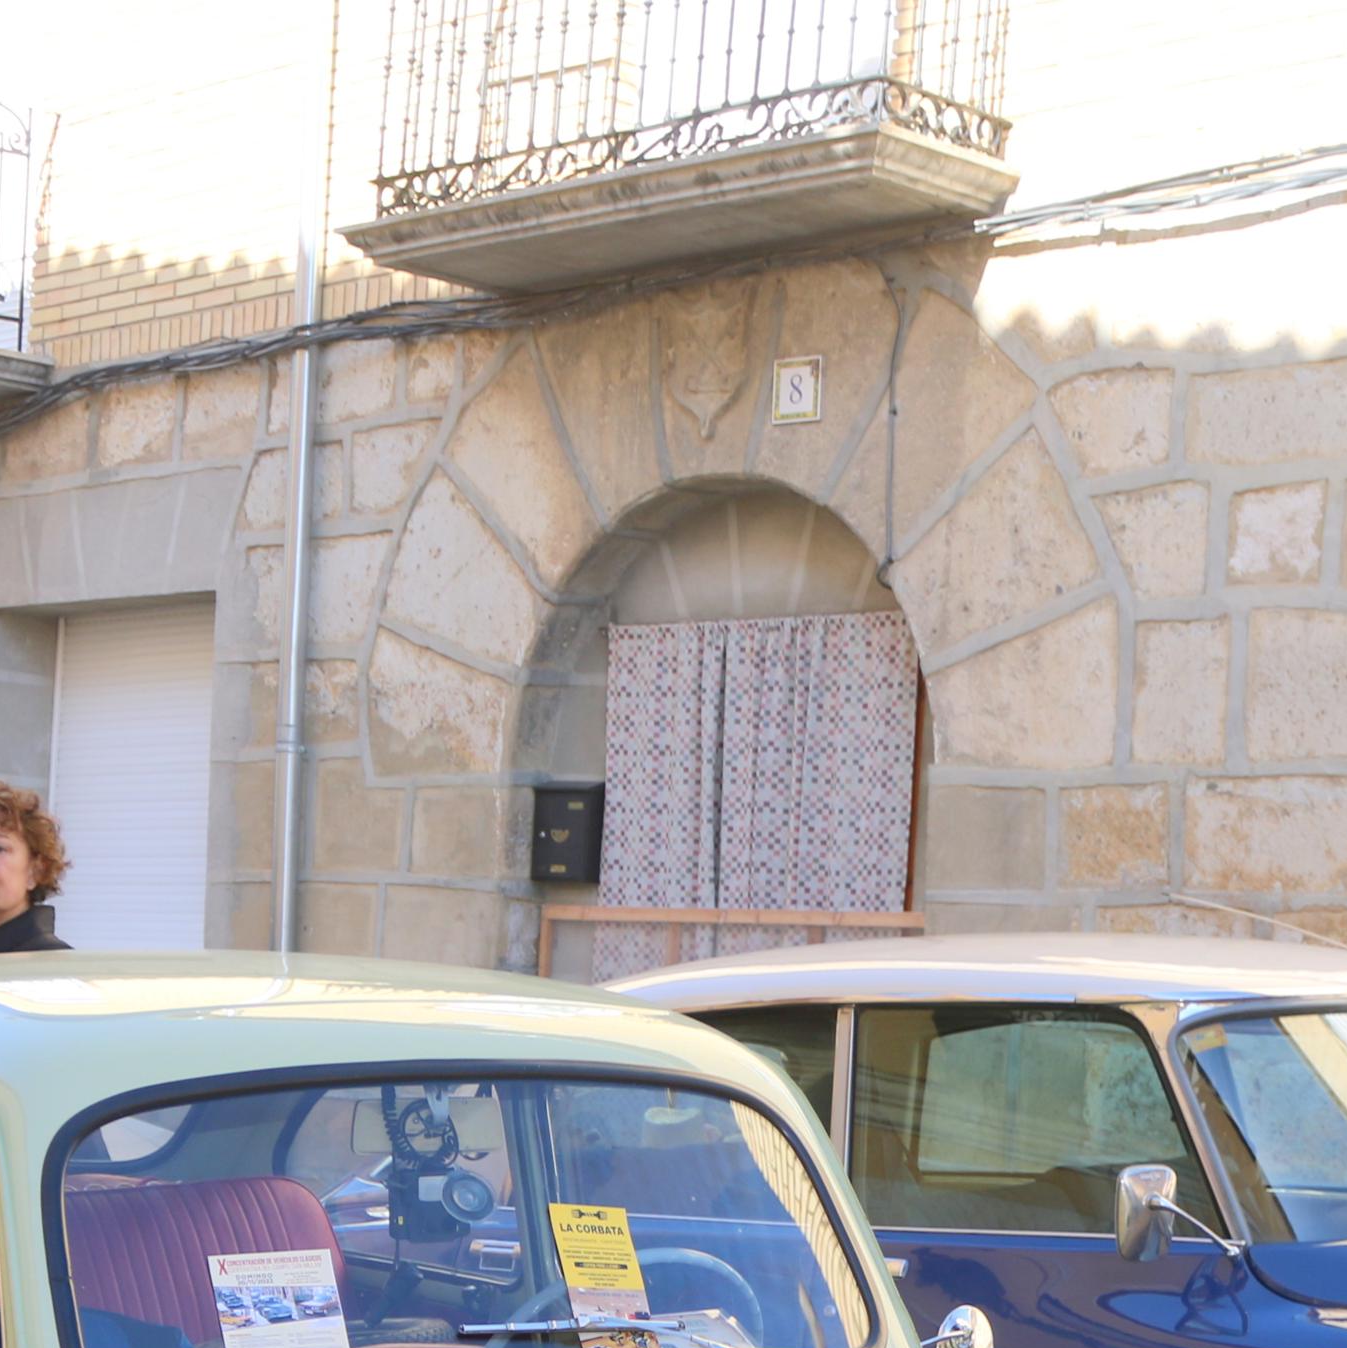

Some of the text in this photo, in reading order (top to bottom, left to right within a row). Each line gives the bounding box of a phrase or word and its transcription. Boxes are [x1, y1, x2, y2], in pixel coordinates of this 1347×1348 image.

[789, 374, 803, 405] 8
[559, 1223, 624, 1236] LA CORBATA
[217, 1259, 228, 1275] X
